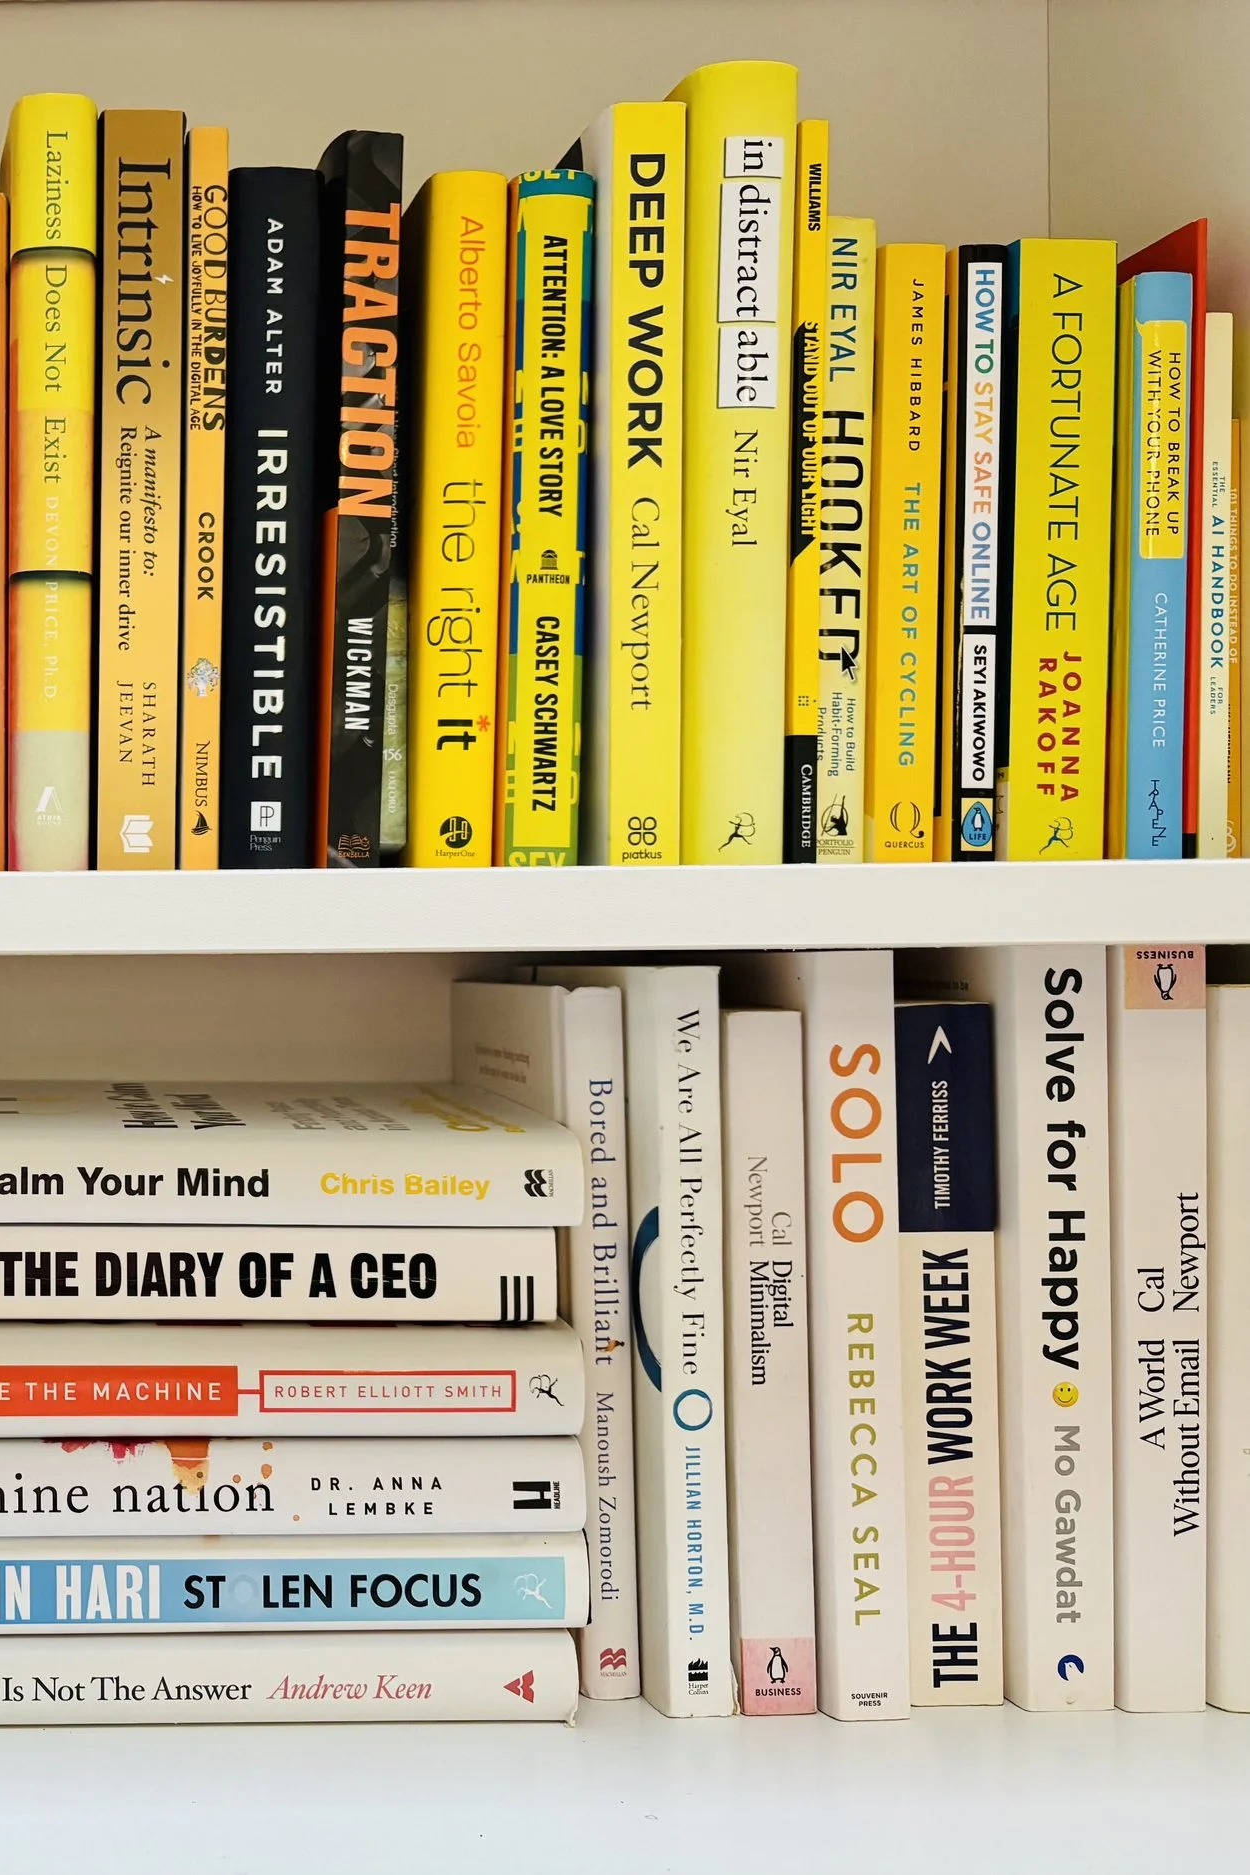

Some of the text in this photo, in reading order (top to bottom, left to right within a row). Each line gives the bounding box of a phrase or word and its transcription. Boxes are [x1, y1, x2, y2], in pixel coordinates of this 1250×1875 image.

[808, 163, 820, 231] WILLIAMS
[116, 157, 171, 405] Intrinsic
[189, 186, 202, 430] HOW TO LIVE JOYFULLY IN THE DIGITAL AGE
[266, 218, 284, 394] ADAM ALTER
[627, 154, 665, 468] DEEP WORK
[338, 203, 400, 518] TRACTION
[909, 279, 925, 451] JAMES HIBBARD
[726, 429, 757, 547] Nir Eyal
[1046, 274, 1083, 631] A FORTUNATE AGE
[197, 512, 215, 601] CROOK
[251, 430, 288, 779] IRRESISTIBLE
[526, 573, 570, 584] PANTHEON
[1210, 516, 1225, 668] AI HANDBOOK
[117, 681, 133, 763] JEEVAN
[142, 682, 156, 787] SHARATH
[345, 617, 373, 730] WICKMAN
[531, 617, 560, 812] CASEY SCHWARTZ
[973, 645, 987, 782] SEYI AKIWOWO
[1153, 593, 1167, 748] CATHERINE PRICE
[77, 1167, 163, 1196] Your
[178, 1168, 269, 1197] Mind
[320, 1173, 490, 1200] Chris Bailey
[830, 1044, 884, 1243] SOLO
[932, 1080, 950, 1211] TIMOTHY FERRISS
[1042, 967, 1086, 1370] Solve for Happy
[274, 1386, 502, 1397] ROBERT ELLIOTT SMITH
[1138, 1339, 1165, 1450] A World
[1173, 1339, 1200, 1536] Without Email
[311, 1477, 442, 1491] DR. ANNA
[329, 1502, 434, 1515] LEMBKE
[923, 1249, 978, 1688] THE 4-HOUR WORK WEEK
[1054, 1425, 1083, 1623] Mo Gawdat
[56, 1564, 161, 1620] HARI
[685, 1446, 704, 1641] JILLIAN HORTON, M.D.
[755, 1688, 801, 1696] BUSINESS
[851, 1692, 888, 1700] SOUVENIR
